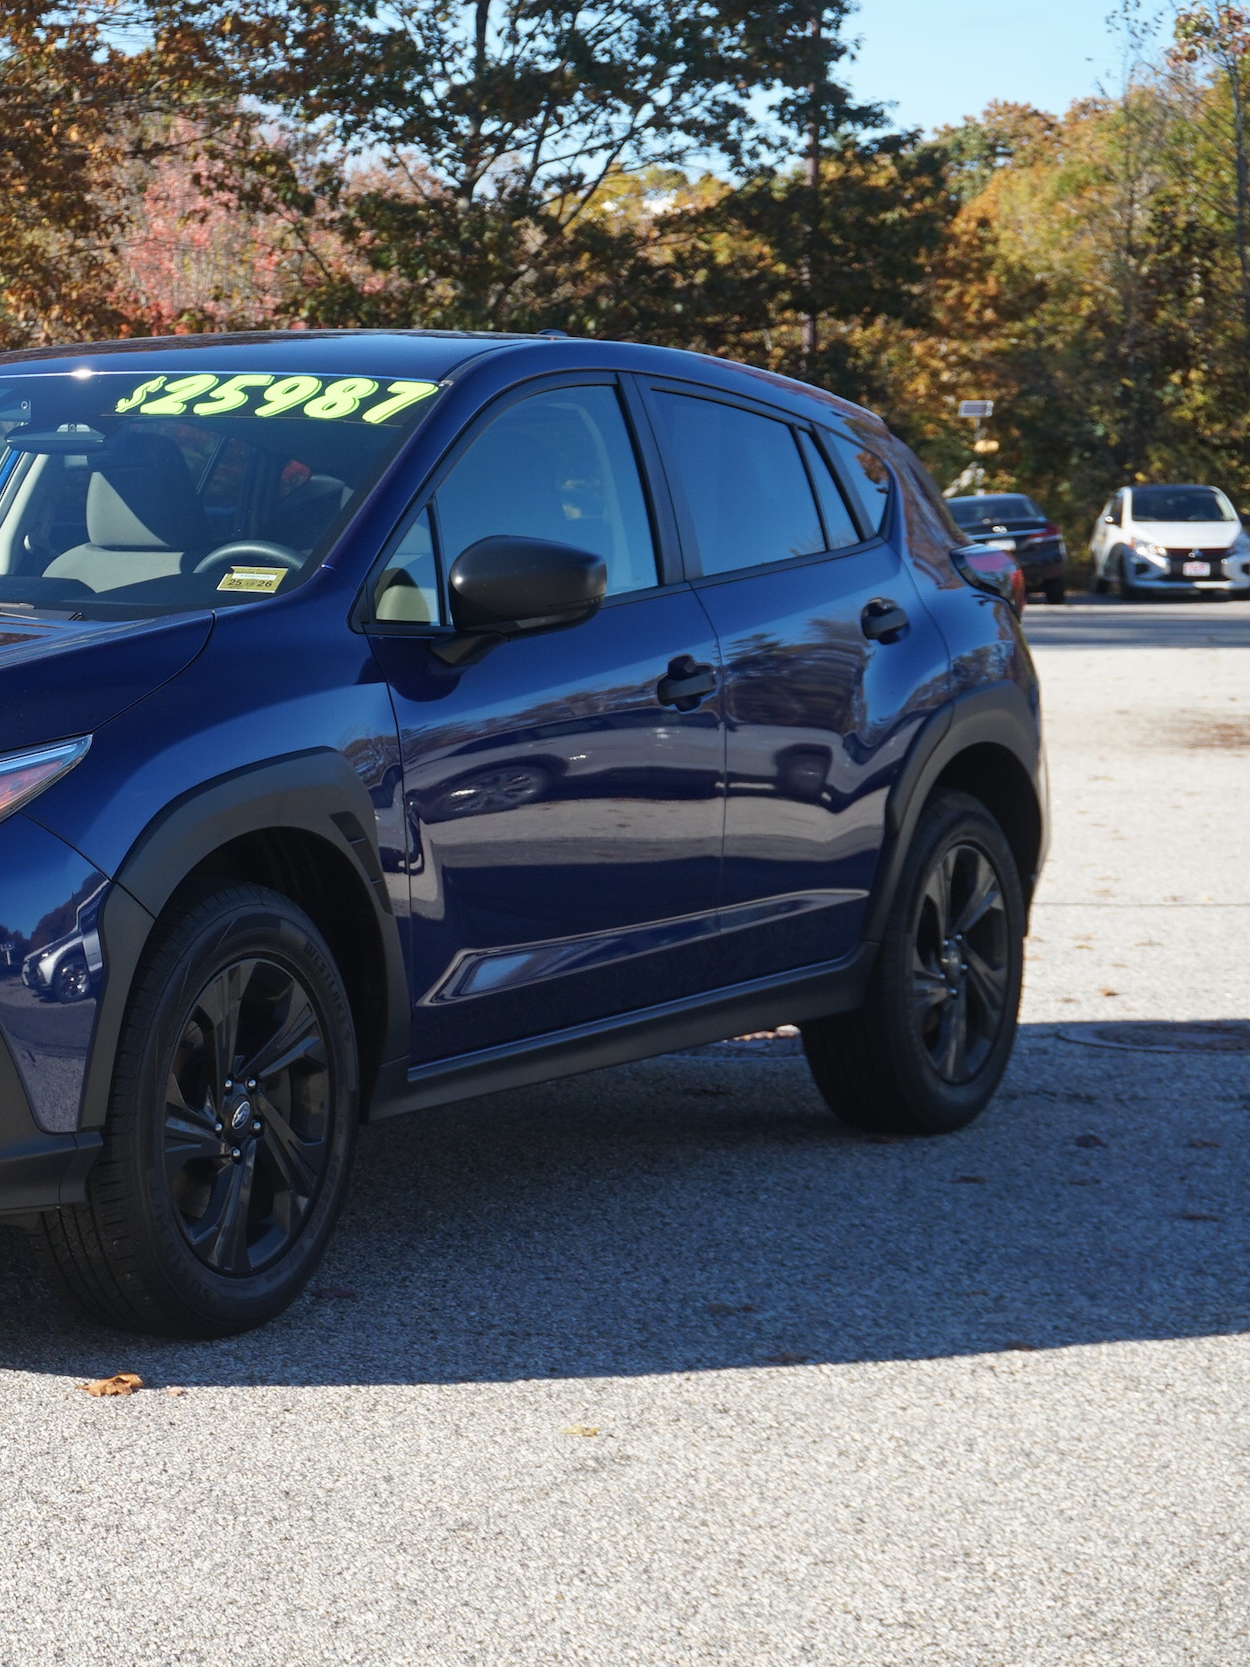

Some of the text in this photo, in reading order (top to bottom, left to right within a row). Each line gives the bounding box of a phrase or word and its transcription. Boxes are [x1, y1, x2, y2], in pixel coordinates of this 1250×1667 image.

[115, 373, 440, 425] $25987
[227, 578, 242, 586] 25
[257, 580, 274, 588] 26
